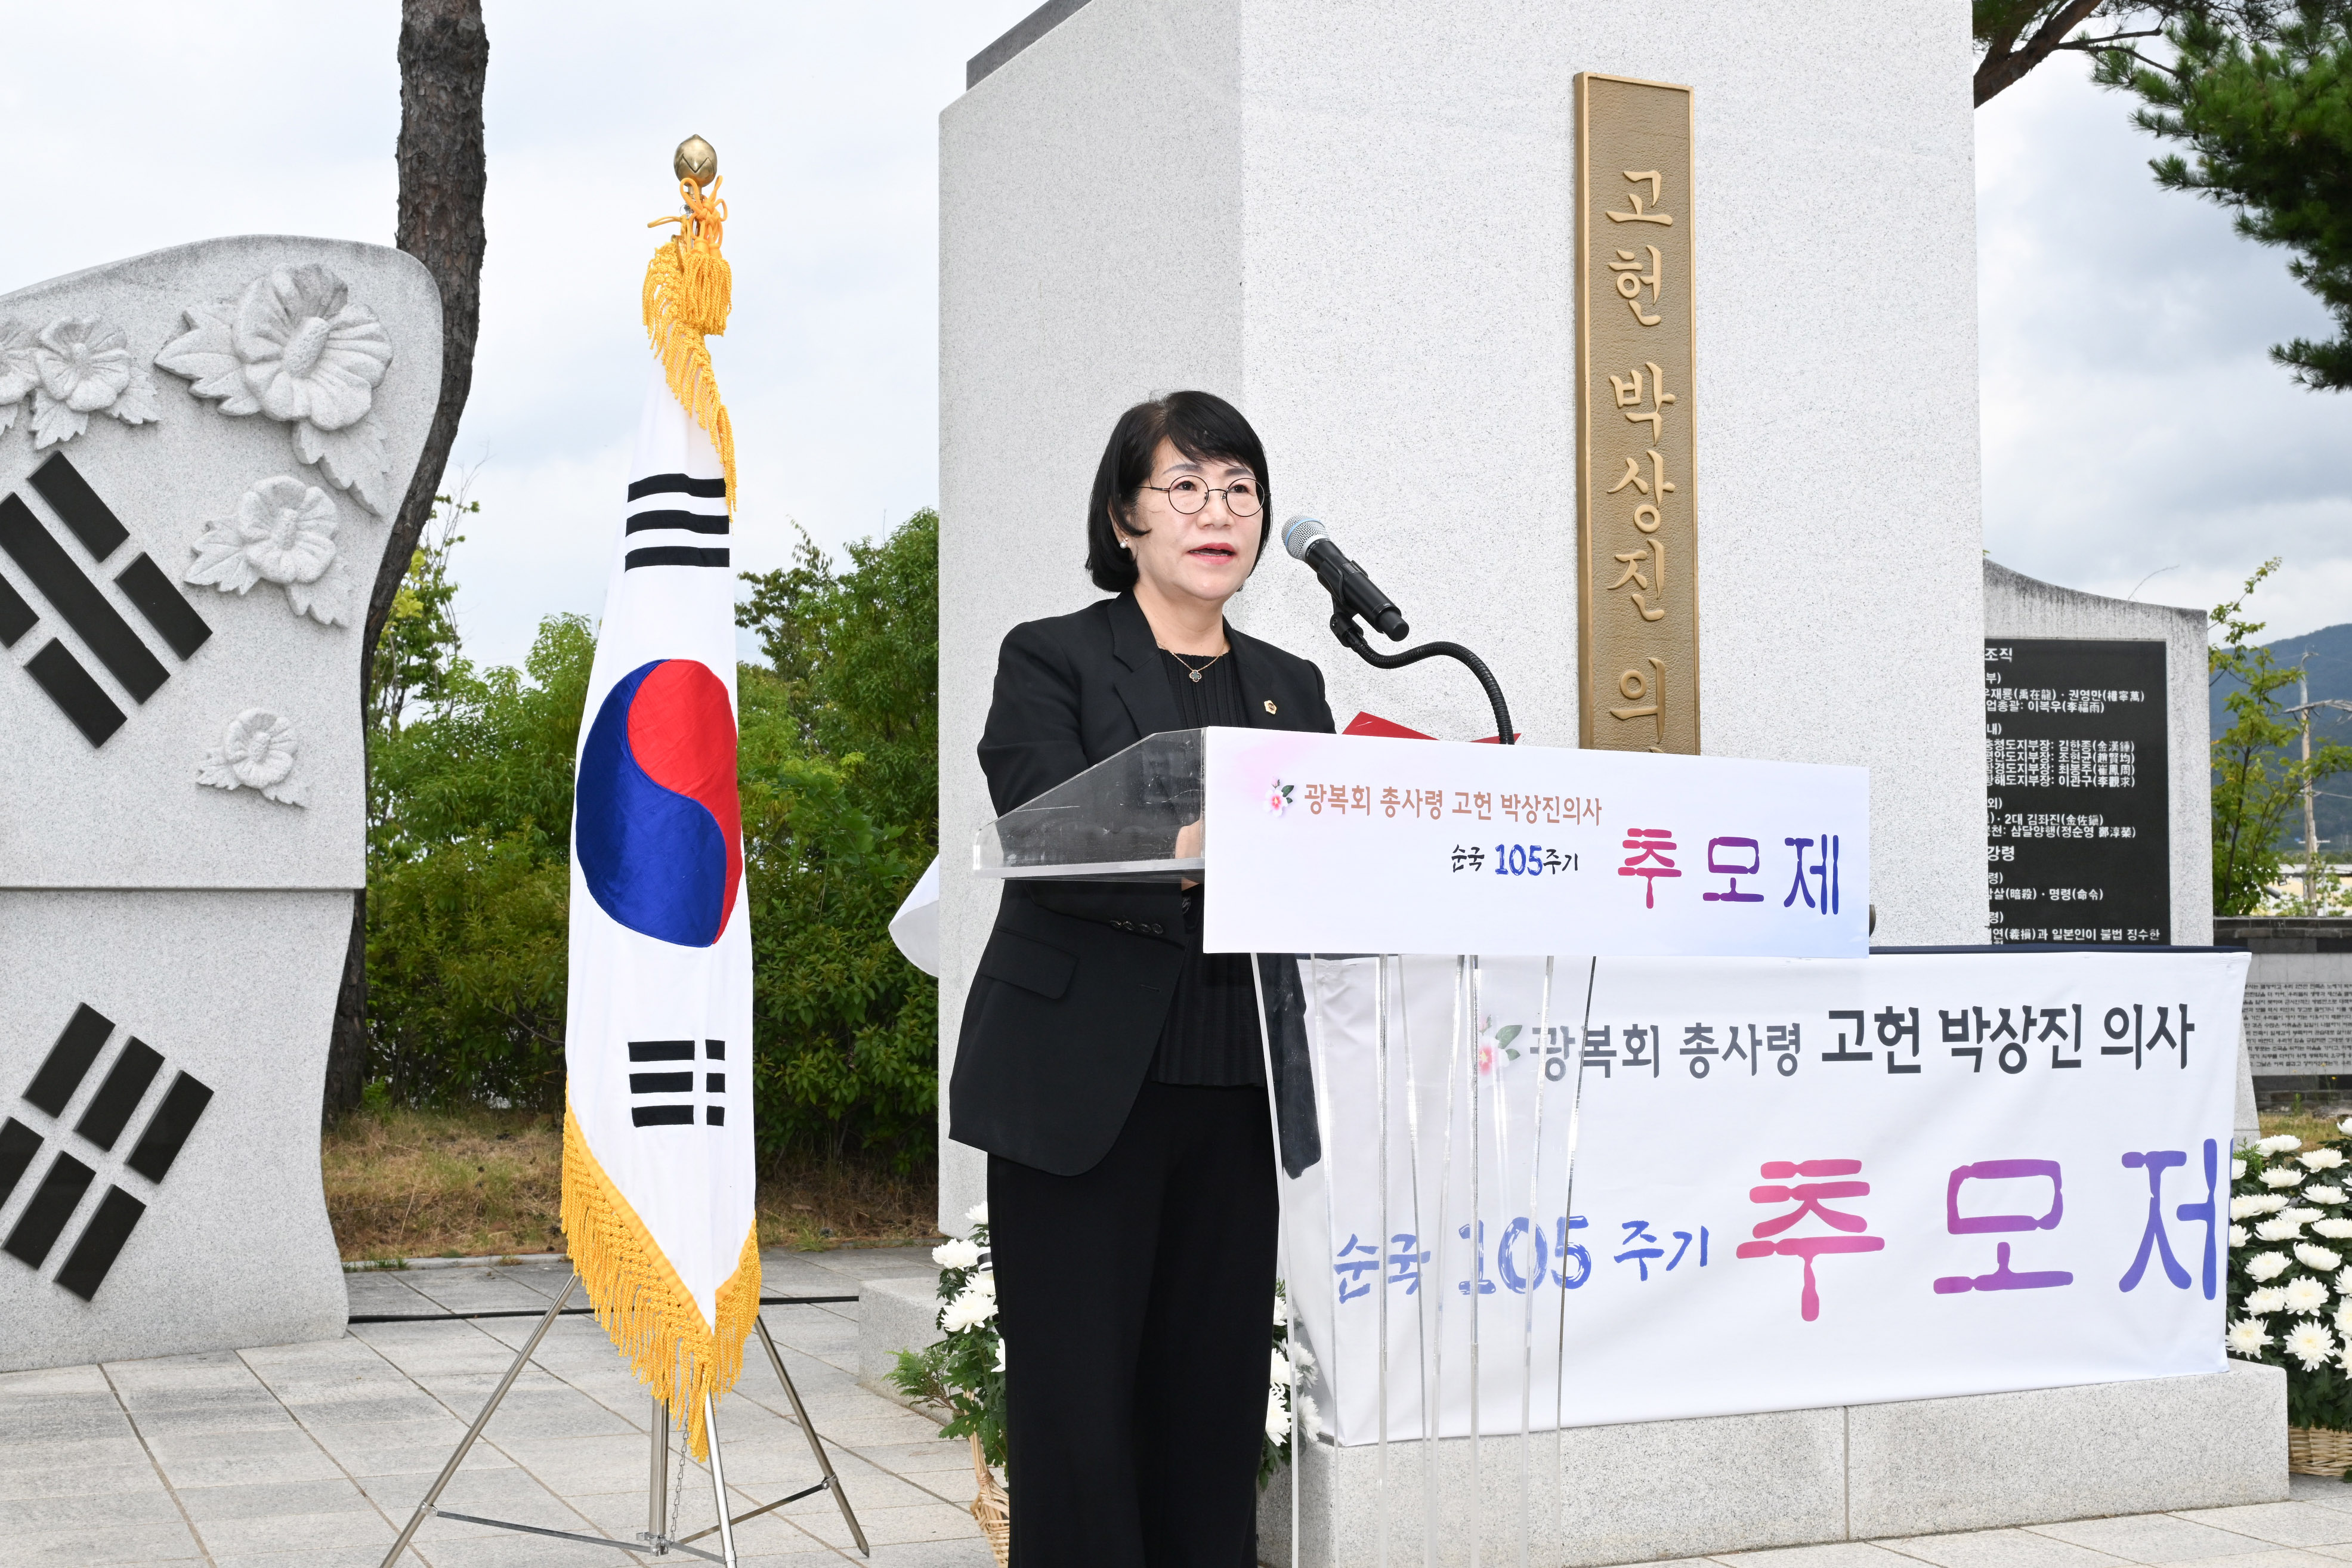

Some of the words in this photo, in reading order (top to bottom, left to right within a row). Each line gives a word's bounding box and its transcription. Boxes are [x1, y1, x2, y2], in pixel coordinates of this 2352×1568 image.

[1605, 169, 1673, 326] 고헌
[1606, 361, 1676, 621] 박상진
[1985, 648, 2013, 663] 조직
[1610, 657, 1666, 753] 의
[1305, 784, 1370, 817] 광복회
[1380, 786, 1442, 820] 총사령
[1452, 791, 1492, 822] 고헌
[1500, 794, 1602, 826] 박상진의사
[2004, 813, 2023, 825] 2대
[1451, 844, 1485, 873] 순국
[1988, 845, 2015, 862] 강령
[2051, 928, 2096, 941] 일본인이
[2100, 929, 2122, 941] 불법
[2127, 929, 2161, 941] 징수한
[1529, 1022, 1660, 1082] 광복회
[1679, 1022, 1801, 1079] 총사령
[1822, 1006, 1921, 1074] 고헌
[1938, 1003, 2082, 1074] 박상진
[2100, 1003, 2195, 1071] 의사
[1333, 1233, 1431, 1304] 순국
